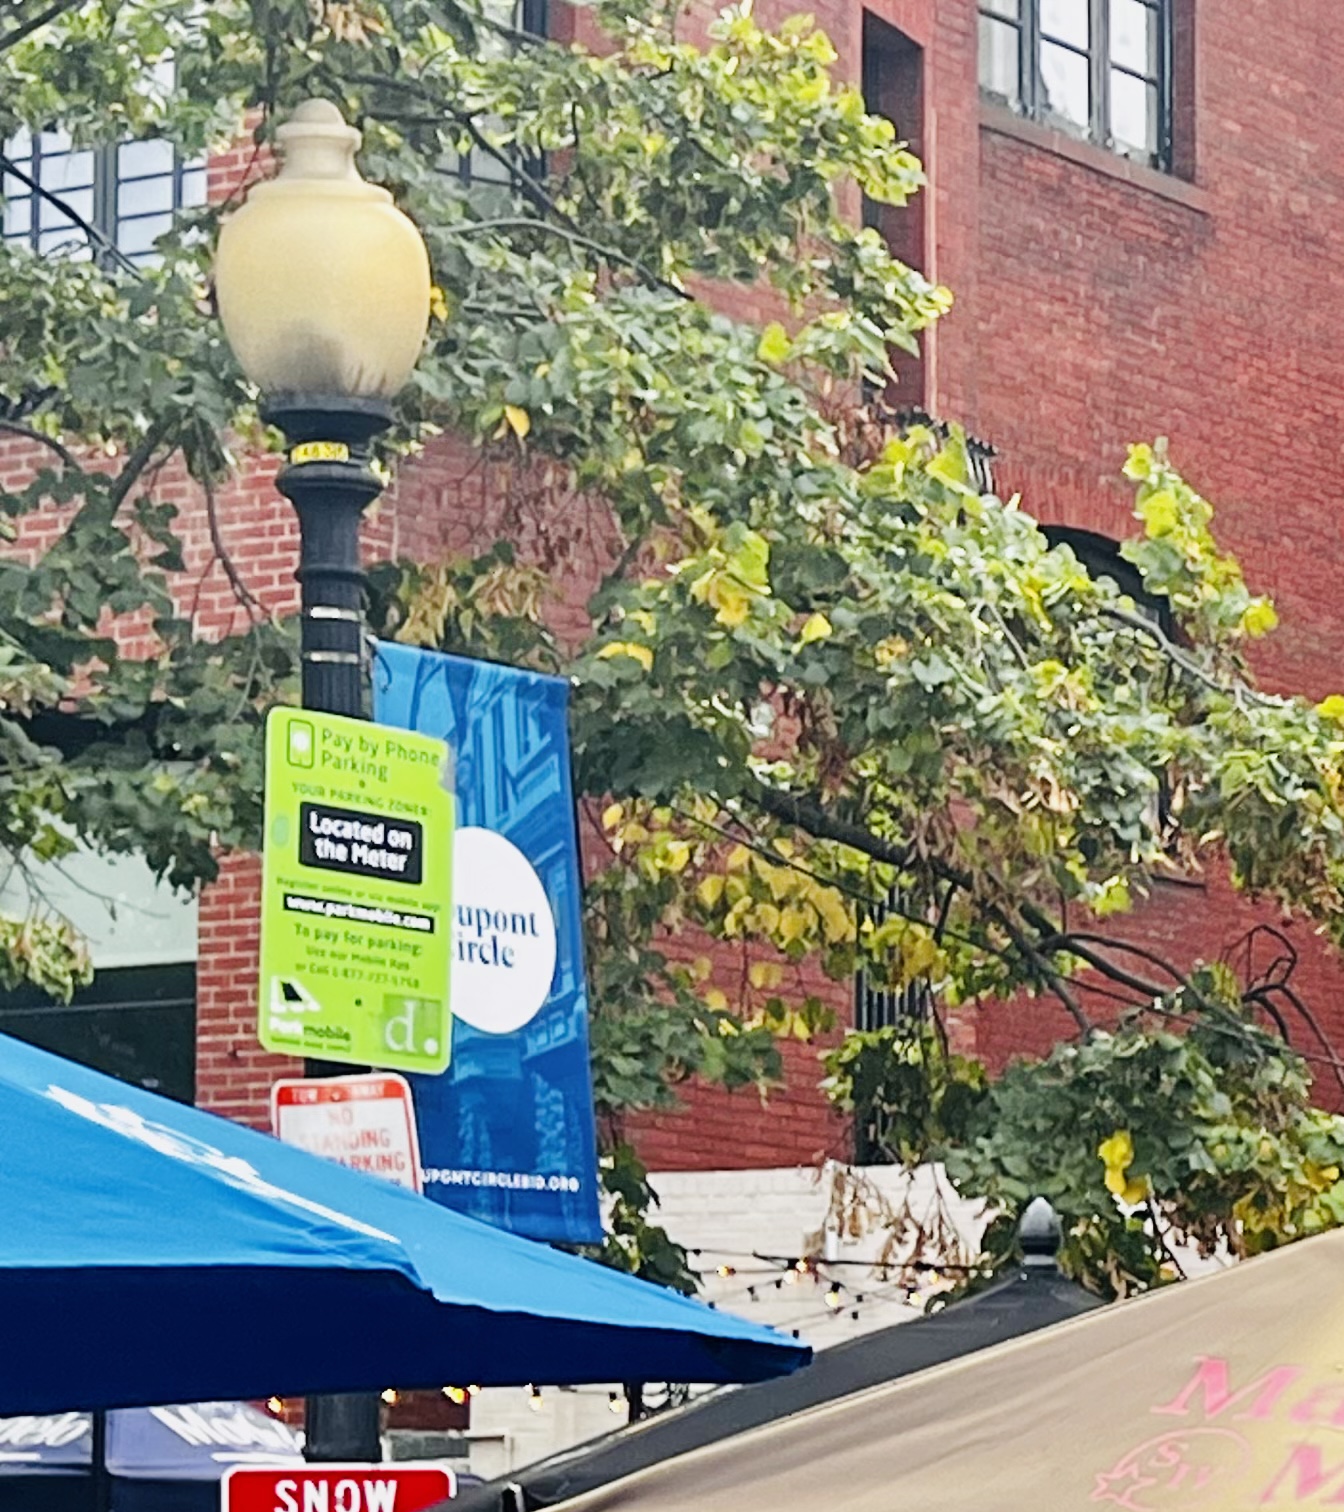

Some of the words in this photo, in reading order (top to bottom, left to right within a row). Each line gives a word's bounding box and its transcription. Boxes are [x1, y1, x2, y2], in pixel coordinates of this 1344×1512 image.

[321, 727, 353, 751] Pay
[358, 735, 379, 758] by
[385, 740, 441, 767] Phone
[321, 751, 389, 783] Parking
[309, 810, 385, 845] Located
[387, 828, 413, 851] on
[314, 837, 349, 863] the
[351, 841, 408, 873] Meter
[294, 922, 310, 938] To
[314, 926, 339, 944] pay
[343, 929, 364, 946] for
[452, 904, 540, 938] upont
[452, 930, 515, 969] ircle
[327, 1151, 406, 1173] ARKING
